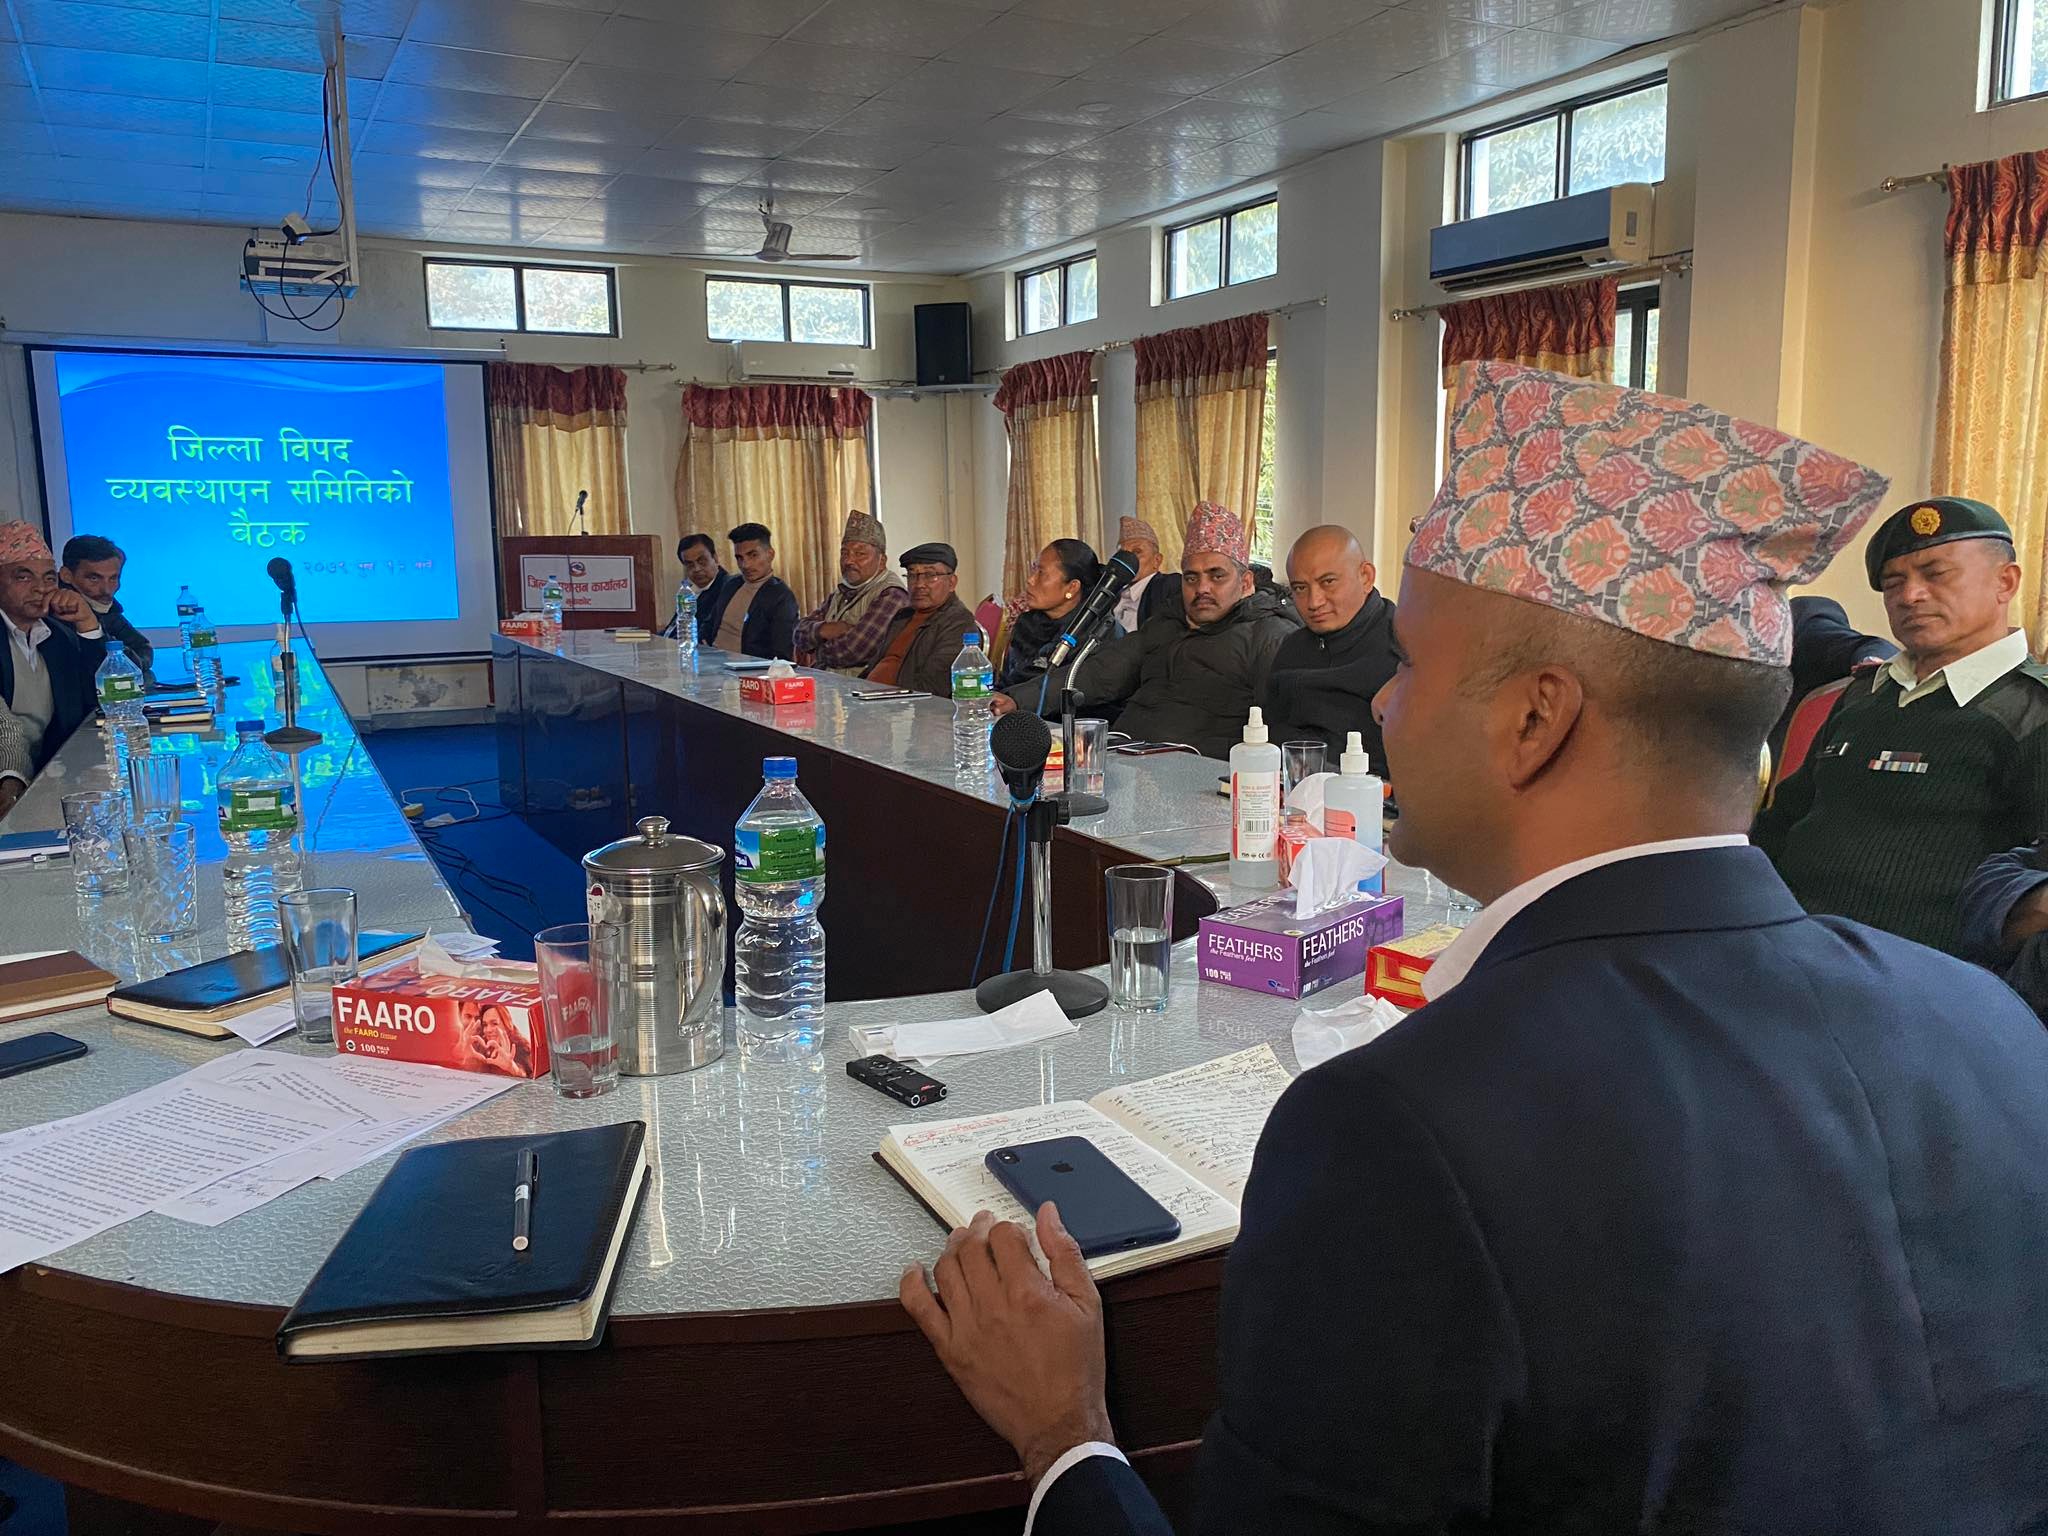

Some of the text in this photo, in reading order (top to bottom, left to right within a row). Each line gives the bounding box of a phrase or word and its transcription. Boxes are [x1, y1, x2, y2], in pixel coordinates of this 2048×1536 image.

[167, 425, 353, 463] जिल्ला विपद
[105, 469, 414, 504] व्यवस्थापन समितिको
[228, 507, 310, 547] बैठक
[1208, 933, 1283, 962] FEATHERS
[1303, 917, 1364, 959] FEATHERS
[1205, 967, 1219, 979] 100
[337, 996, 436, 1035] FAARO
[353, 1027, 379, 1038] FAARO
[360, 1043, 376, 1053] 100
